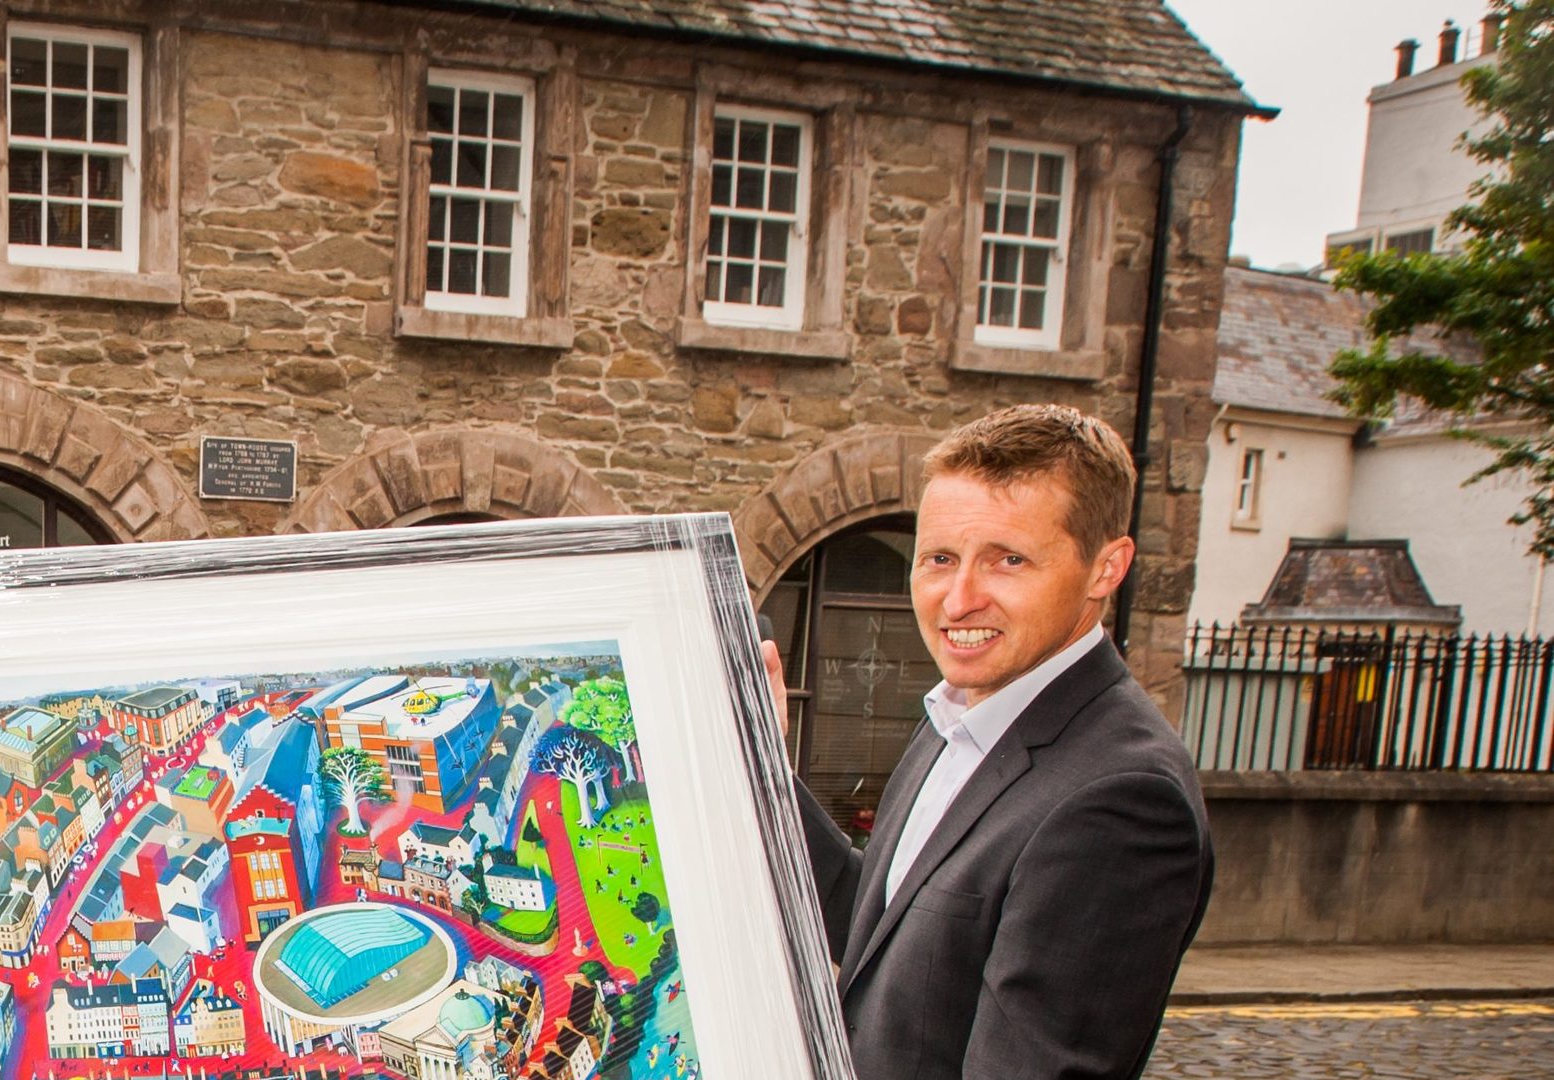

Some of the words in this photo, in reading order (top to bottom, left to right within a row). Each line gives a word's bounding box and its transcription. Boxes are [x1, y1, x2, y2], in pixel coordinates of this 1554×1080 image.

[867, 616, 883, 633] N
[825, 659, 842, 675] W
[863, 702, 874, 718] S
